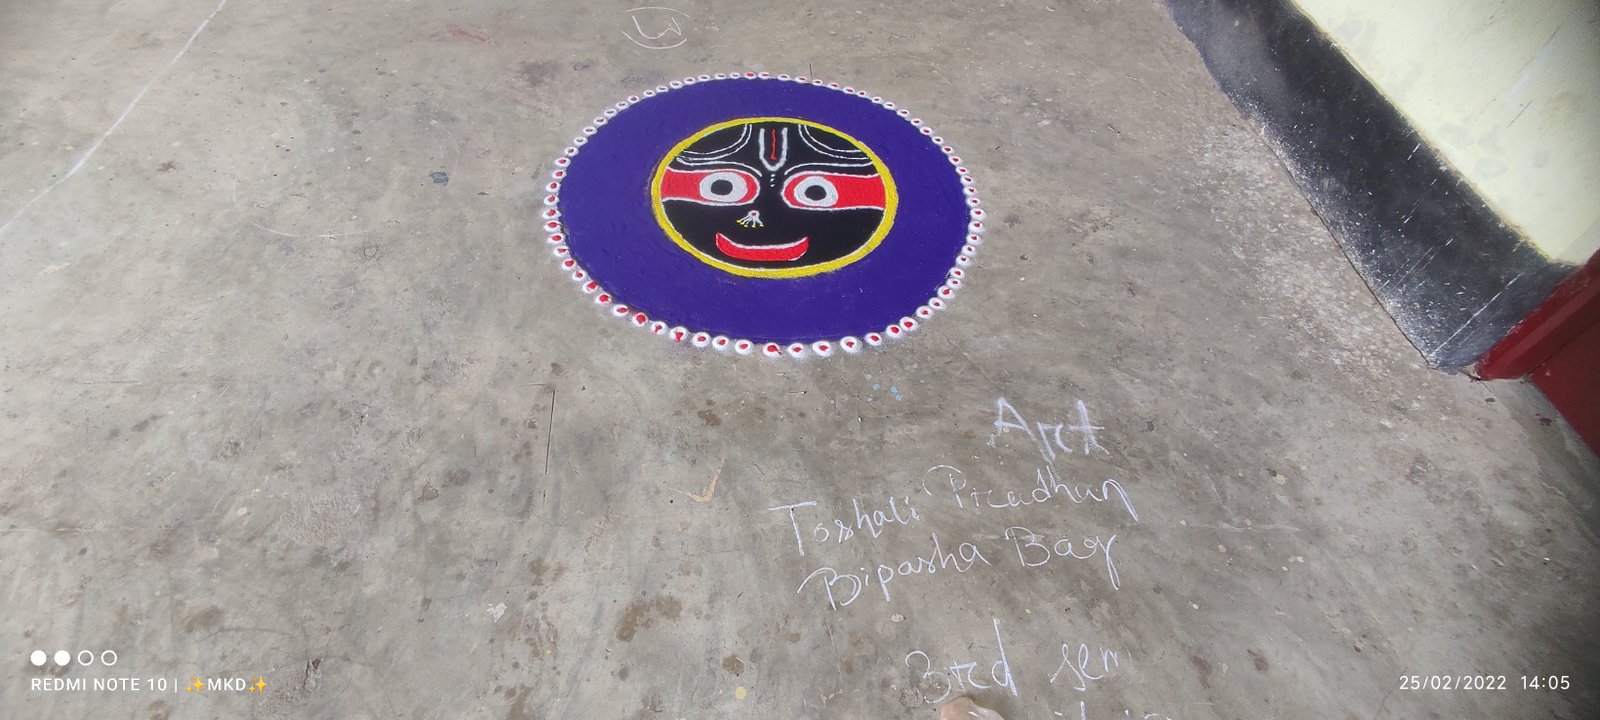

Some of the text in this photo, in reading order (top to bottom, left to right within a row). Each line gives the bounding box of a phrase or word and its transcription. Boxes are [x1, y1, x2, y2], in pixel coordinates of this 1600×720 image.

[986, 396, 1110, 468] Art
[768, 496, 920, 557] Toshali
[797, 532, 992, 611] Bipasha
[904, 616, 1018, 704] 3rd
